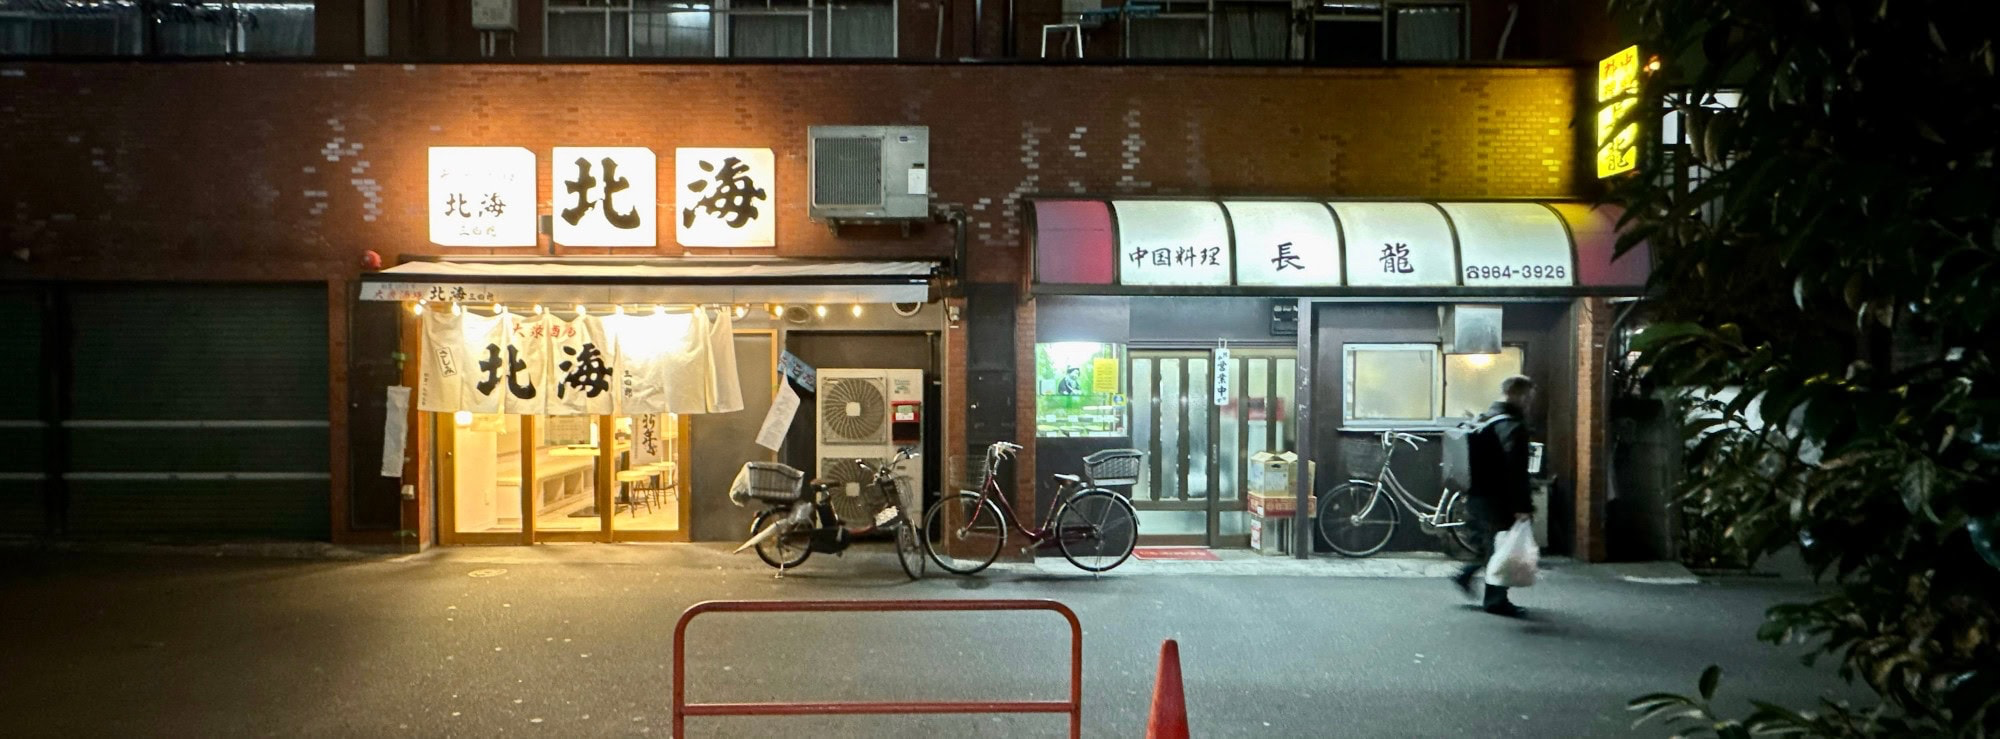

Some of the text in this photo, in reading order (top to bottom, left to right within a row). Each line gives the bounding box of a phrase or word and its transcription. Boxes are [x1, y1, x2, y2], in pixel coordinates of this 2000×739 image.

[445, 193, 507, 218] 北海
[561, 157, 767, 230] 北海
[1129, 246, 1221, 268] 中国料理
[1271, 241, 1415, 274] 長龍
[1482, 265, 1566, 279] 964-3926
[430, 286, 467, 300] 北海
[477, 342, 614, 400] 北海
[1217, 360, 1227, 397] 営業中
